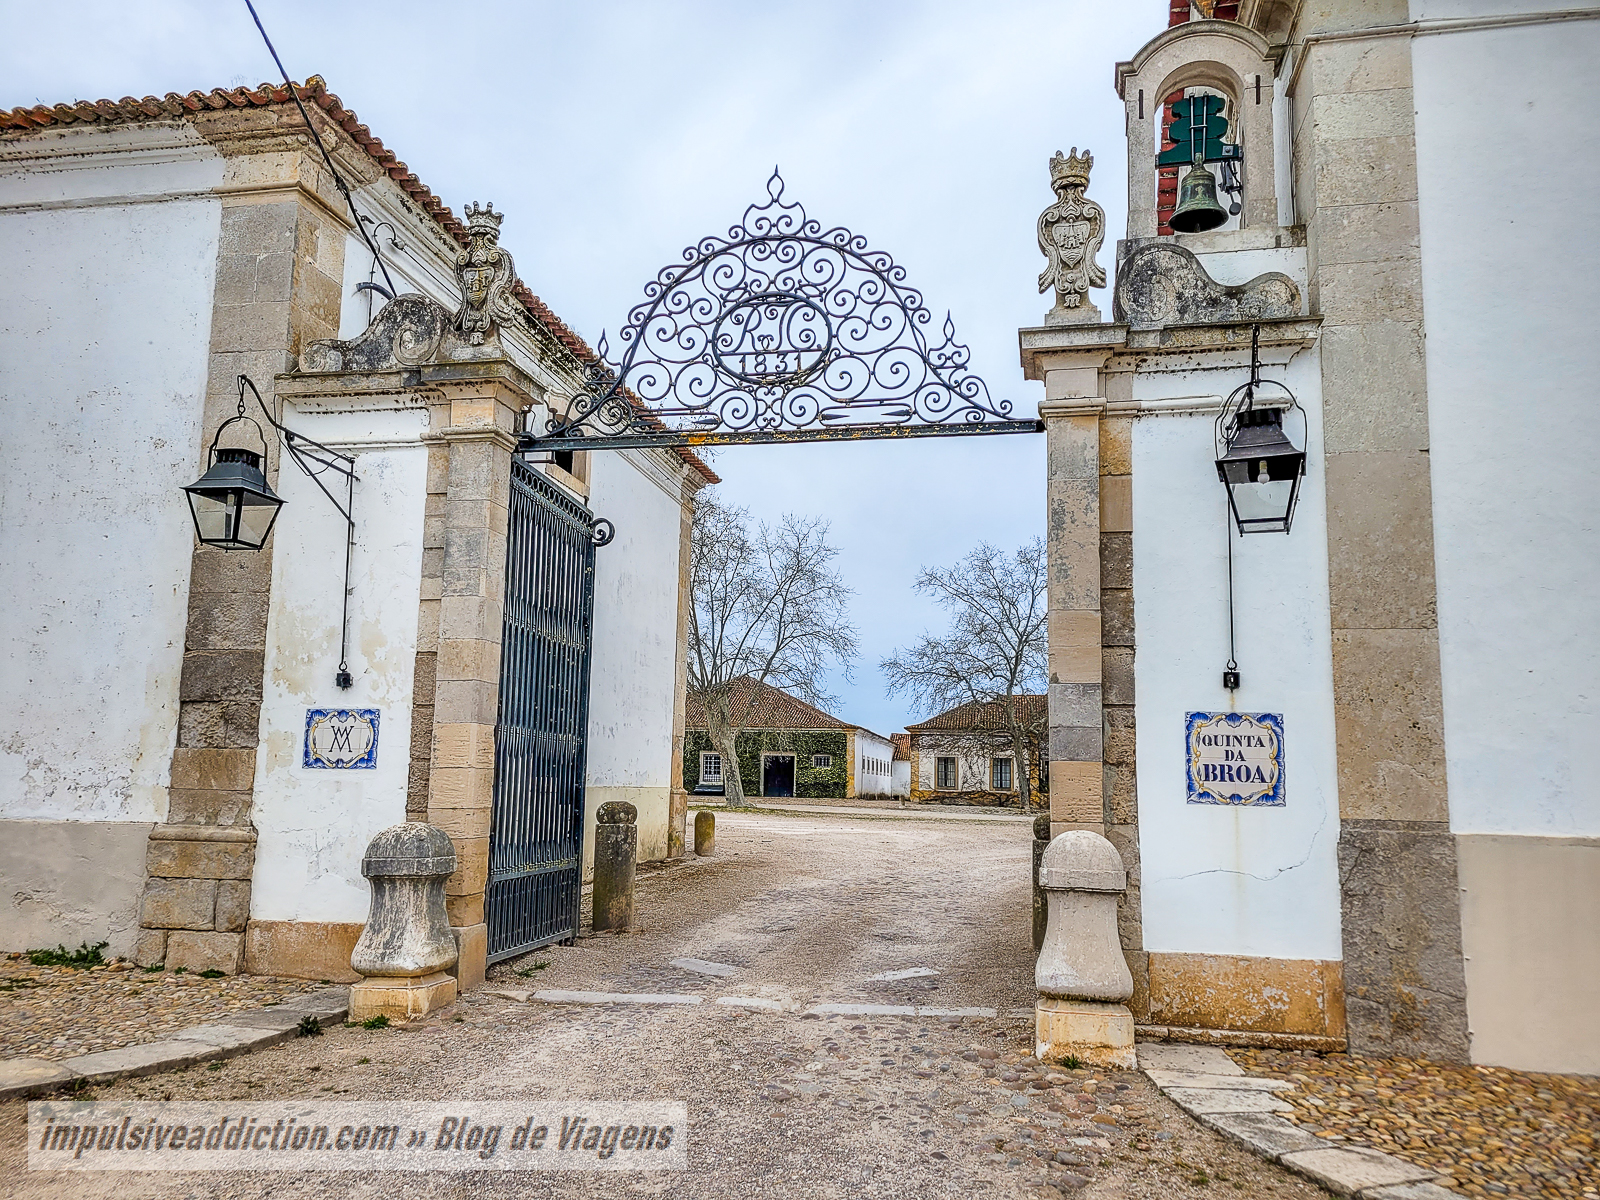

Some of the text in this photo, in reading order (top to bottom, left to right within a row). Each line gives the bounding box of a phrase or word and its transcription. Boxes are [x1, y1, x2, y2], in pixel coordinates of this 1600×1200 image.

[739, 351, 802, 374] 1831
[1201, 734, 1266, 748] QUINTA
[1224, 749, 1247, 762] DA
[1202, 763, 1267, 783] BROA
